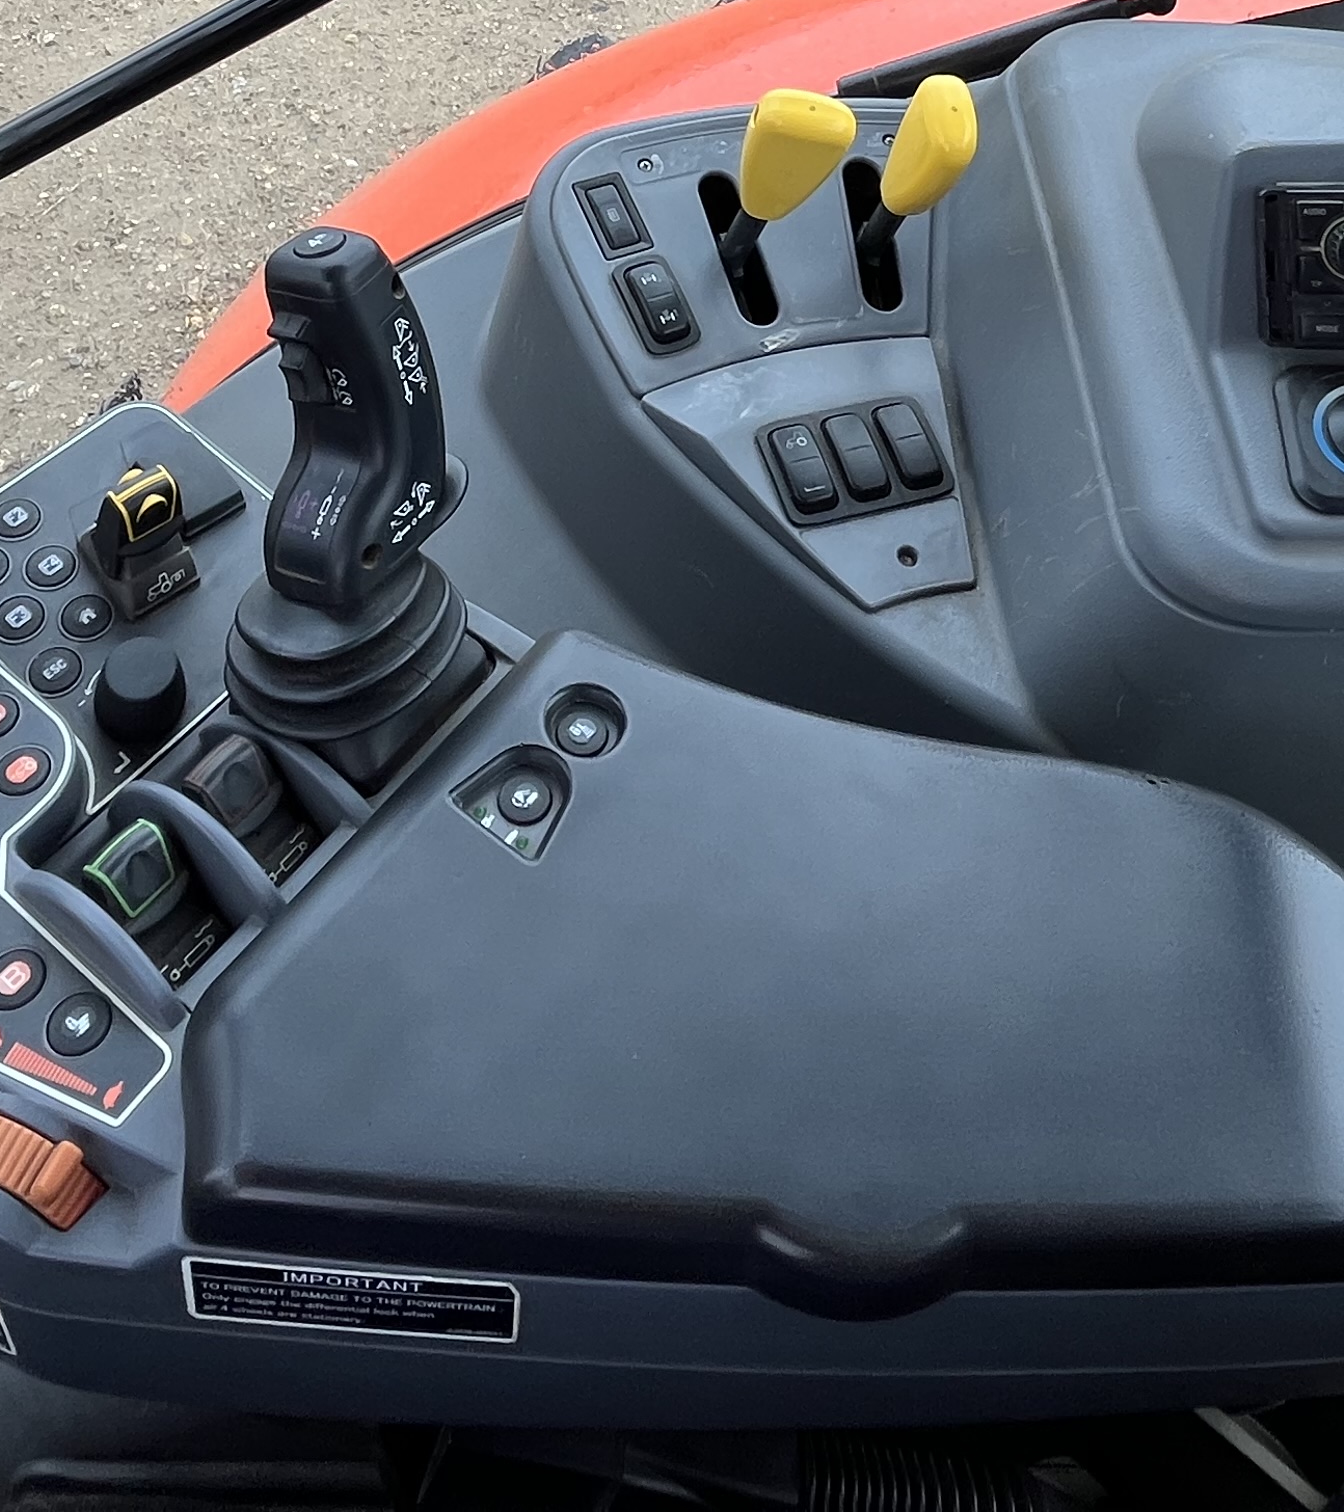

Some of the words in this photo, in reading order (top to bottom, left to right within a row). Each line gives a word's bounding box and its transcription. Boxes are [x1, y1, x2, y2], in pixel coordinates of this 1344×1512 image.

[1315, 324, 1339, 333] MODE
[42, 658, 69, 679] ESC
[0, 965, 27, 991] B
[200, 1280, 220, 1290] TO
[223, 1283, 286, 1297] PREVENT
[290, 1290, 349, 1302] DAMAGE
[353, 1294, 372, 1304] TO
[376, 1296, 403, 1306] THE
[282, 1271, 424, 1294] IMPORTANT
[201, 1292, 230, 1303] Only
[280, 1299, 302, 1308] the
[304, 1301, 371, 1315] differential
[373, 1307, 400, 1317] lock
[402, 1309, 436, 1319] when
